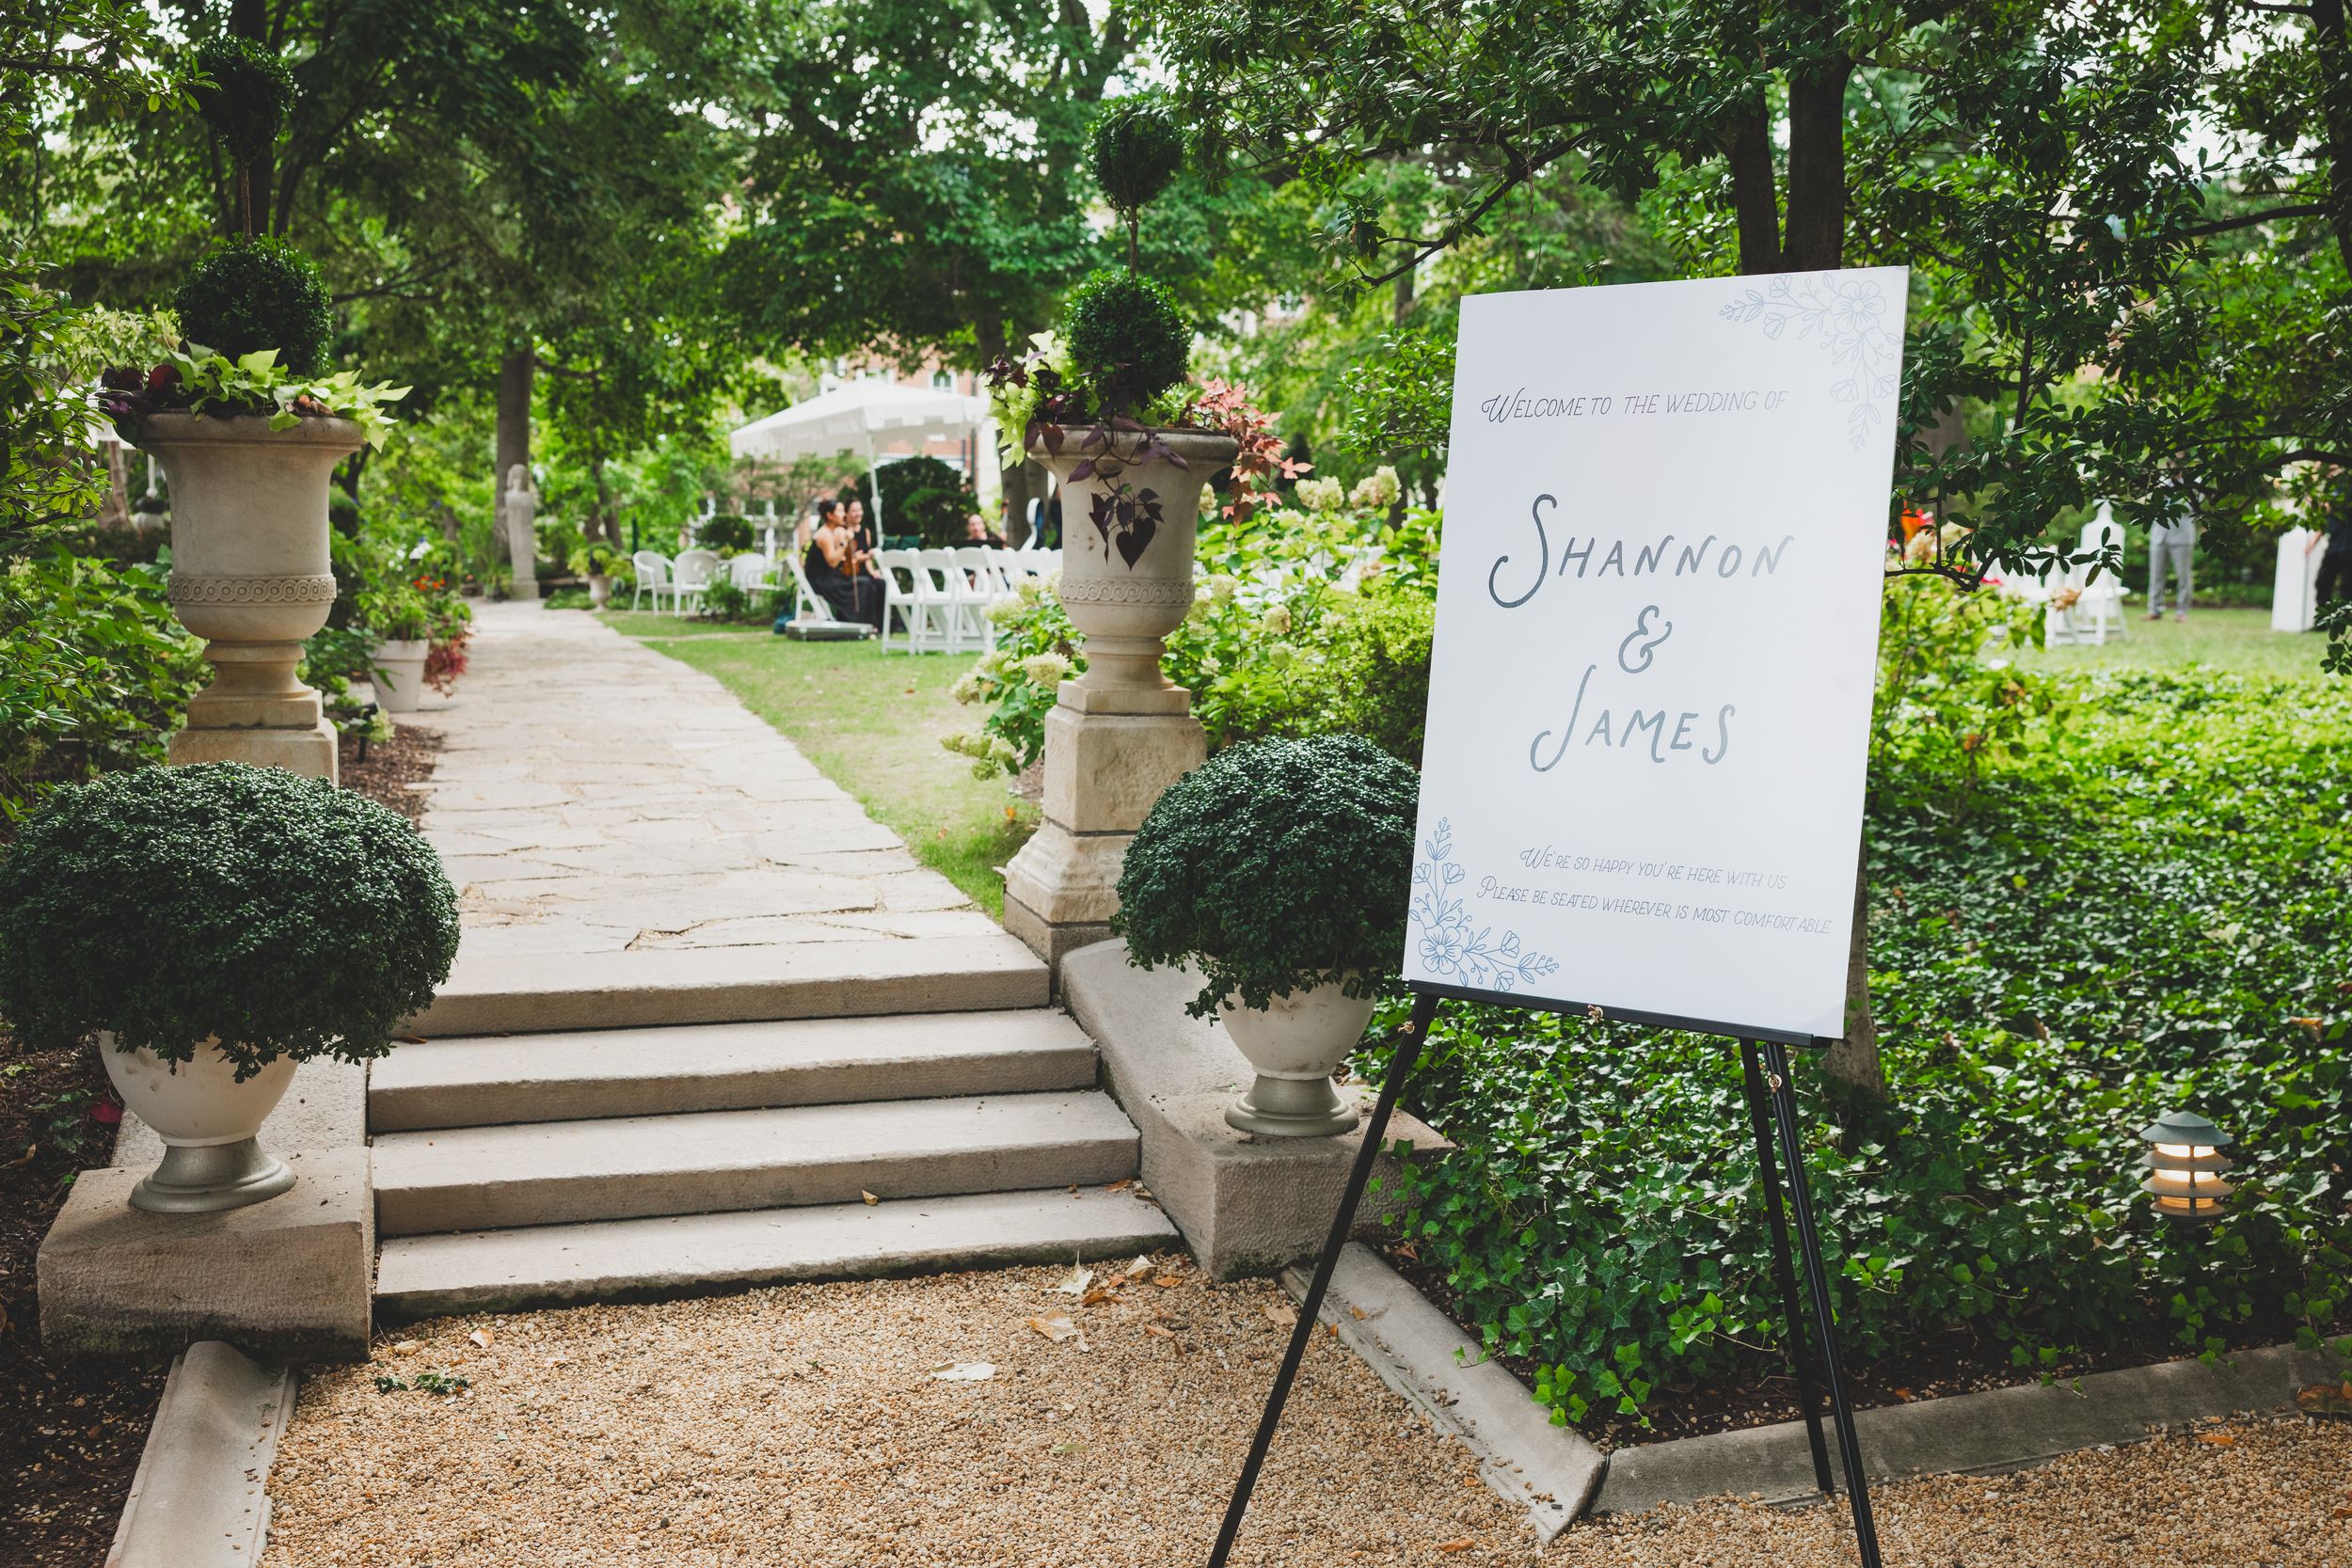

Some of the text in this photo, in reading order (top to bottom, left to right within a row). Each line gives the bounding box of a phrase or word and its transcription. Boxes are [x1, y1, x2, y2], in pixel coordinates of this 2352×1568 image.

[1482, 388, 1789, 423] WELCOME TO THE WEDDING OF
[1488, 494, 1795, 609] SHANNON
[1618, 605, 1673, 673] &
[1530, 664, 1735, 772] JAMES
[1520, 845, 1787, 889] WE'RE SO HAPPY YOU'RE HERE WITH US
[1477, 876, 1529, 902] PLEASE
[1533, 889, 1548, 904] BE
[1551, 891, 1597, 909] SEATED
[1602, 896, 1671, 918] WHEREVER
[1676, 904, 1689, 919] IS
[1692, 907, 1730, 923] MOST
